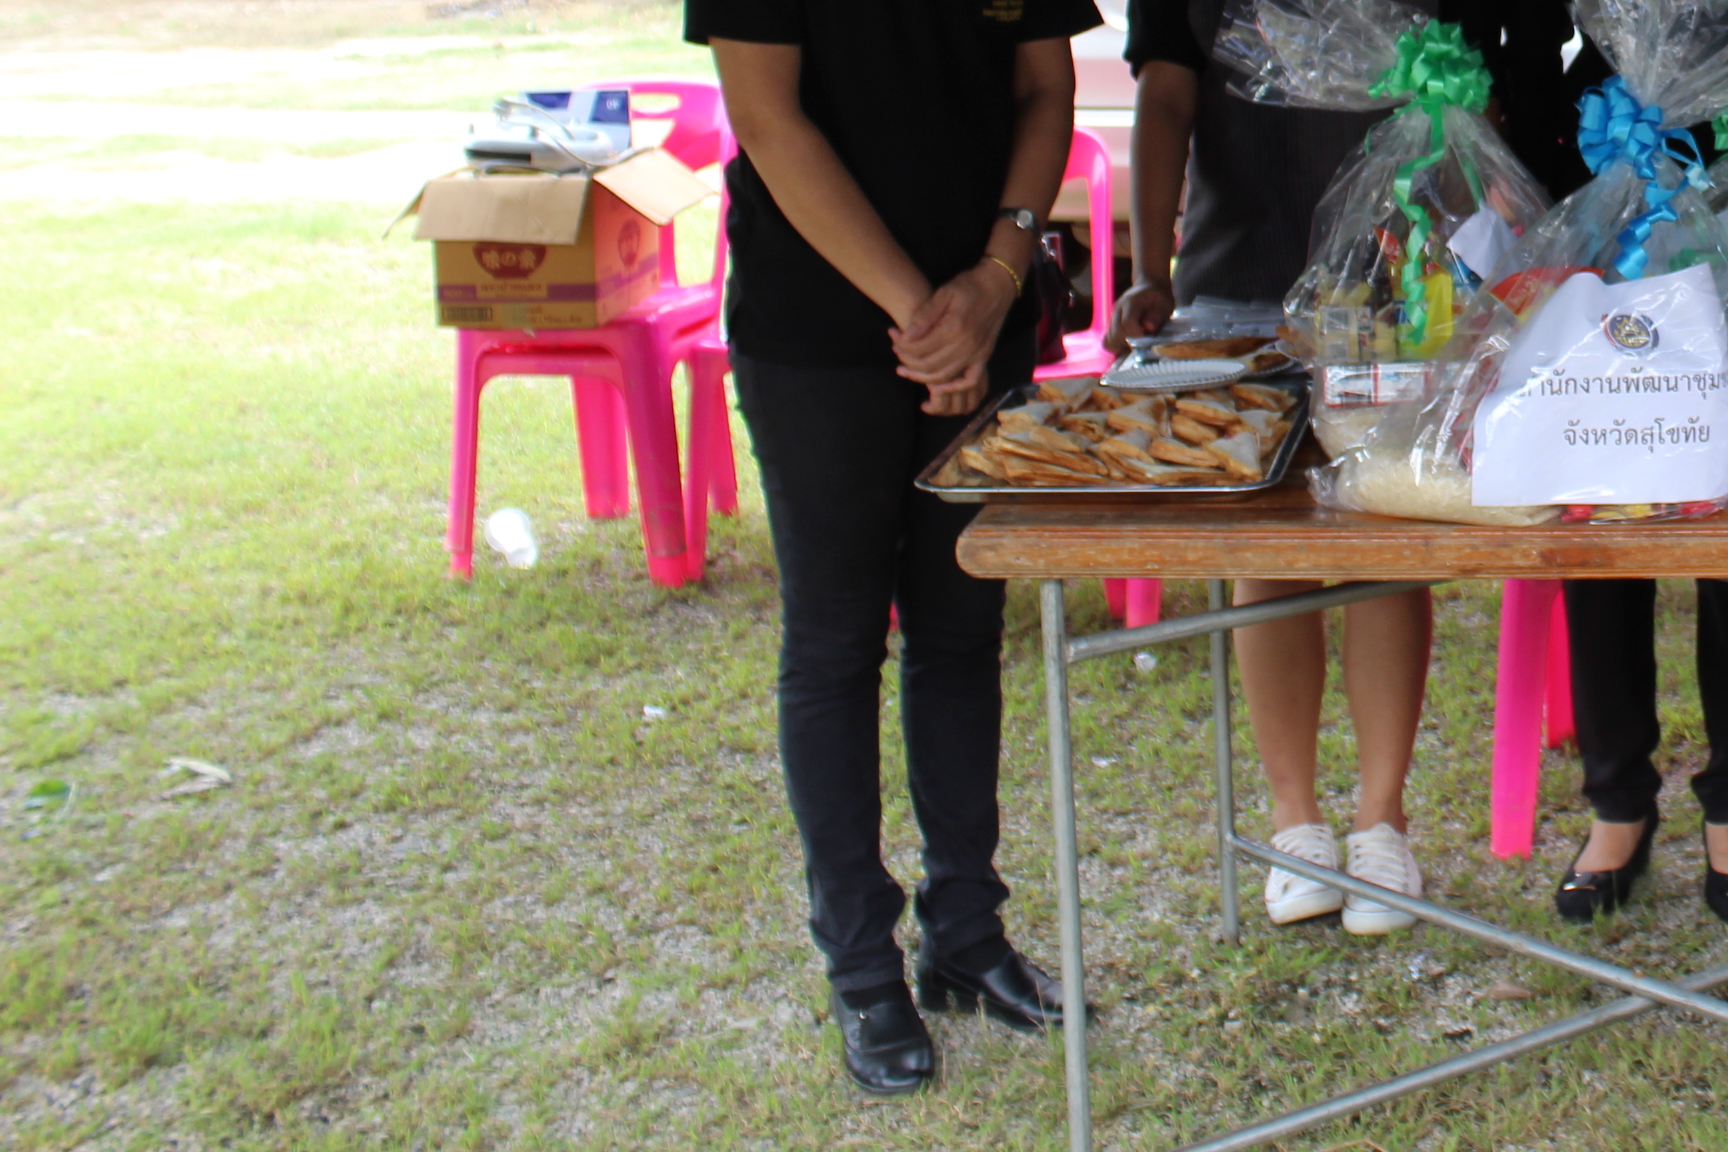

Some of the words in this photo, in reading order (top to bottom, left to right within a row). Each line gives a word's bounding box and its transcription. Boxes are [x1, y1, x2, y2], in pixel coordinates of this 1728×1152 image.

[1562, 417, 1711, 453] จังหวัดสุโขทัย
